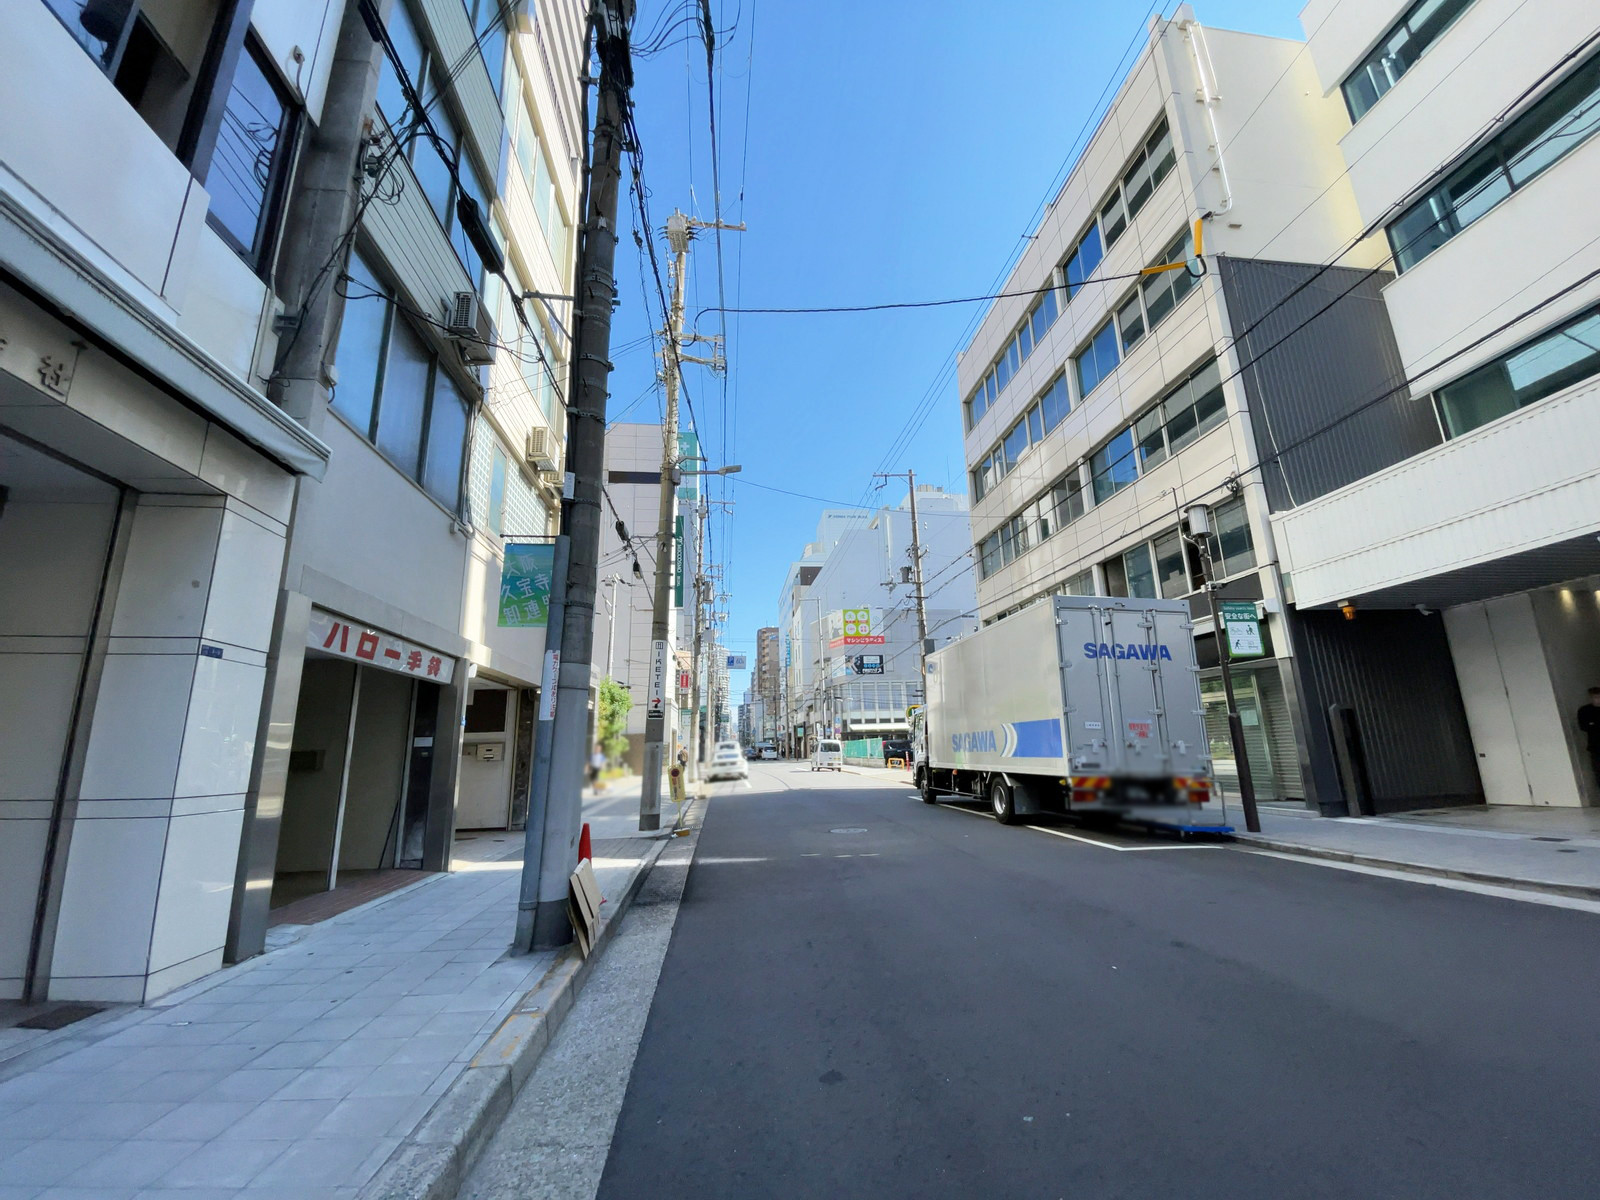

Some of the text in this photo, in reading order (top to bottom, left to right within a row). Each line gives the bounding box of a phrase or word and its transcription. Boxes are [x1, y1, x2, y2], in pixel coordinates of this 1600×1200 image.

[506, 553, 539, 579] 大阪
[501, 570, 552, 604] 久宝寺
[1083, 642, 1172, 661] SAGAWA
[654, 651, 662, 696] IKETEI
[951, 730, 998, 752] SAGAWA
